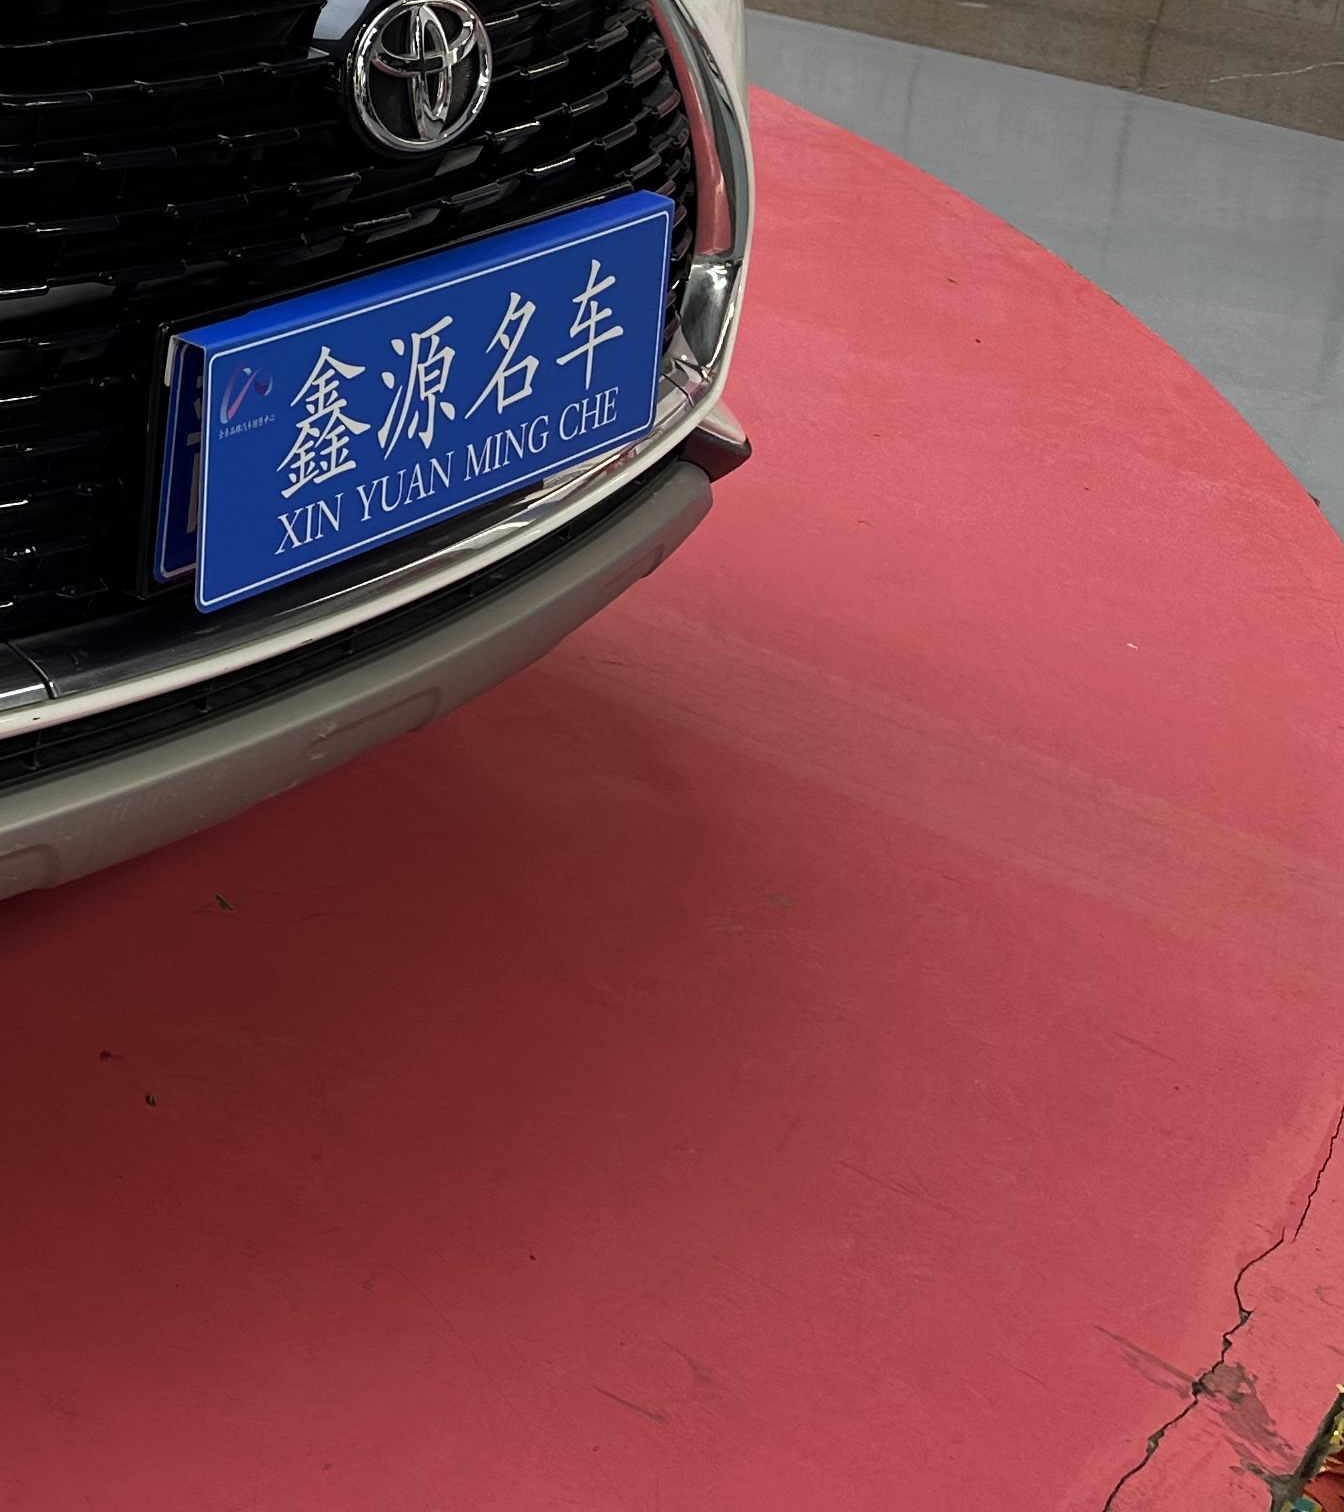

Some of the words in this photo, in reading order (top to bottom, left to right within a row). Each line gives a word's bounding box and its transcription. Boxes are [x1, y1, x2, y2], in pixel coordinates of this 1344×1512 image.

[275, 493, 344, 555] XIN
[356, 451, 455, 523] YUAN
[464, 415, 550, 481] MING
[559, 387, 619, 441] CHE
[277, 259, 624, 498] 鑫源名车
